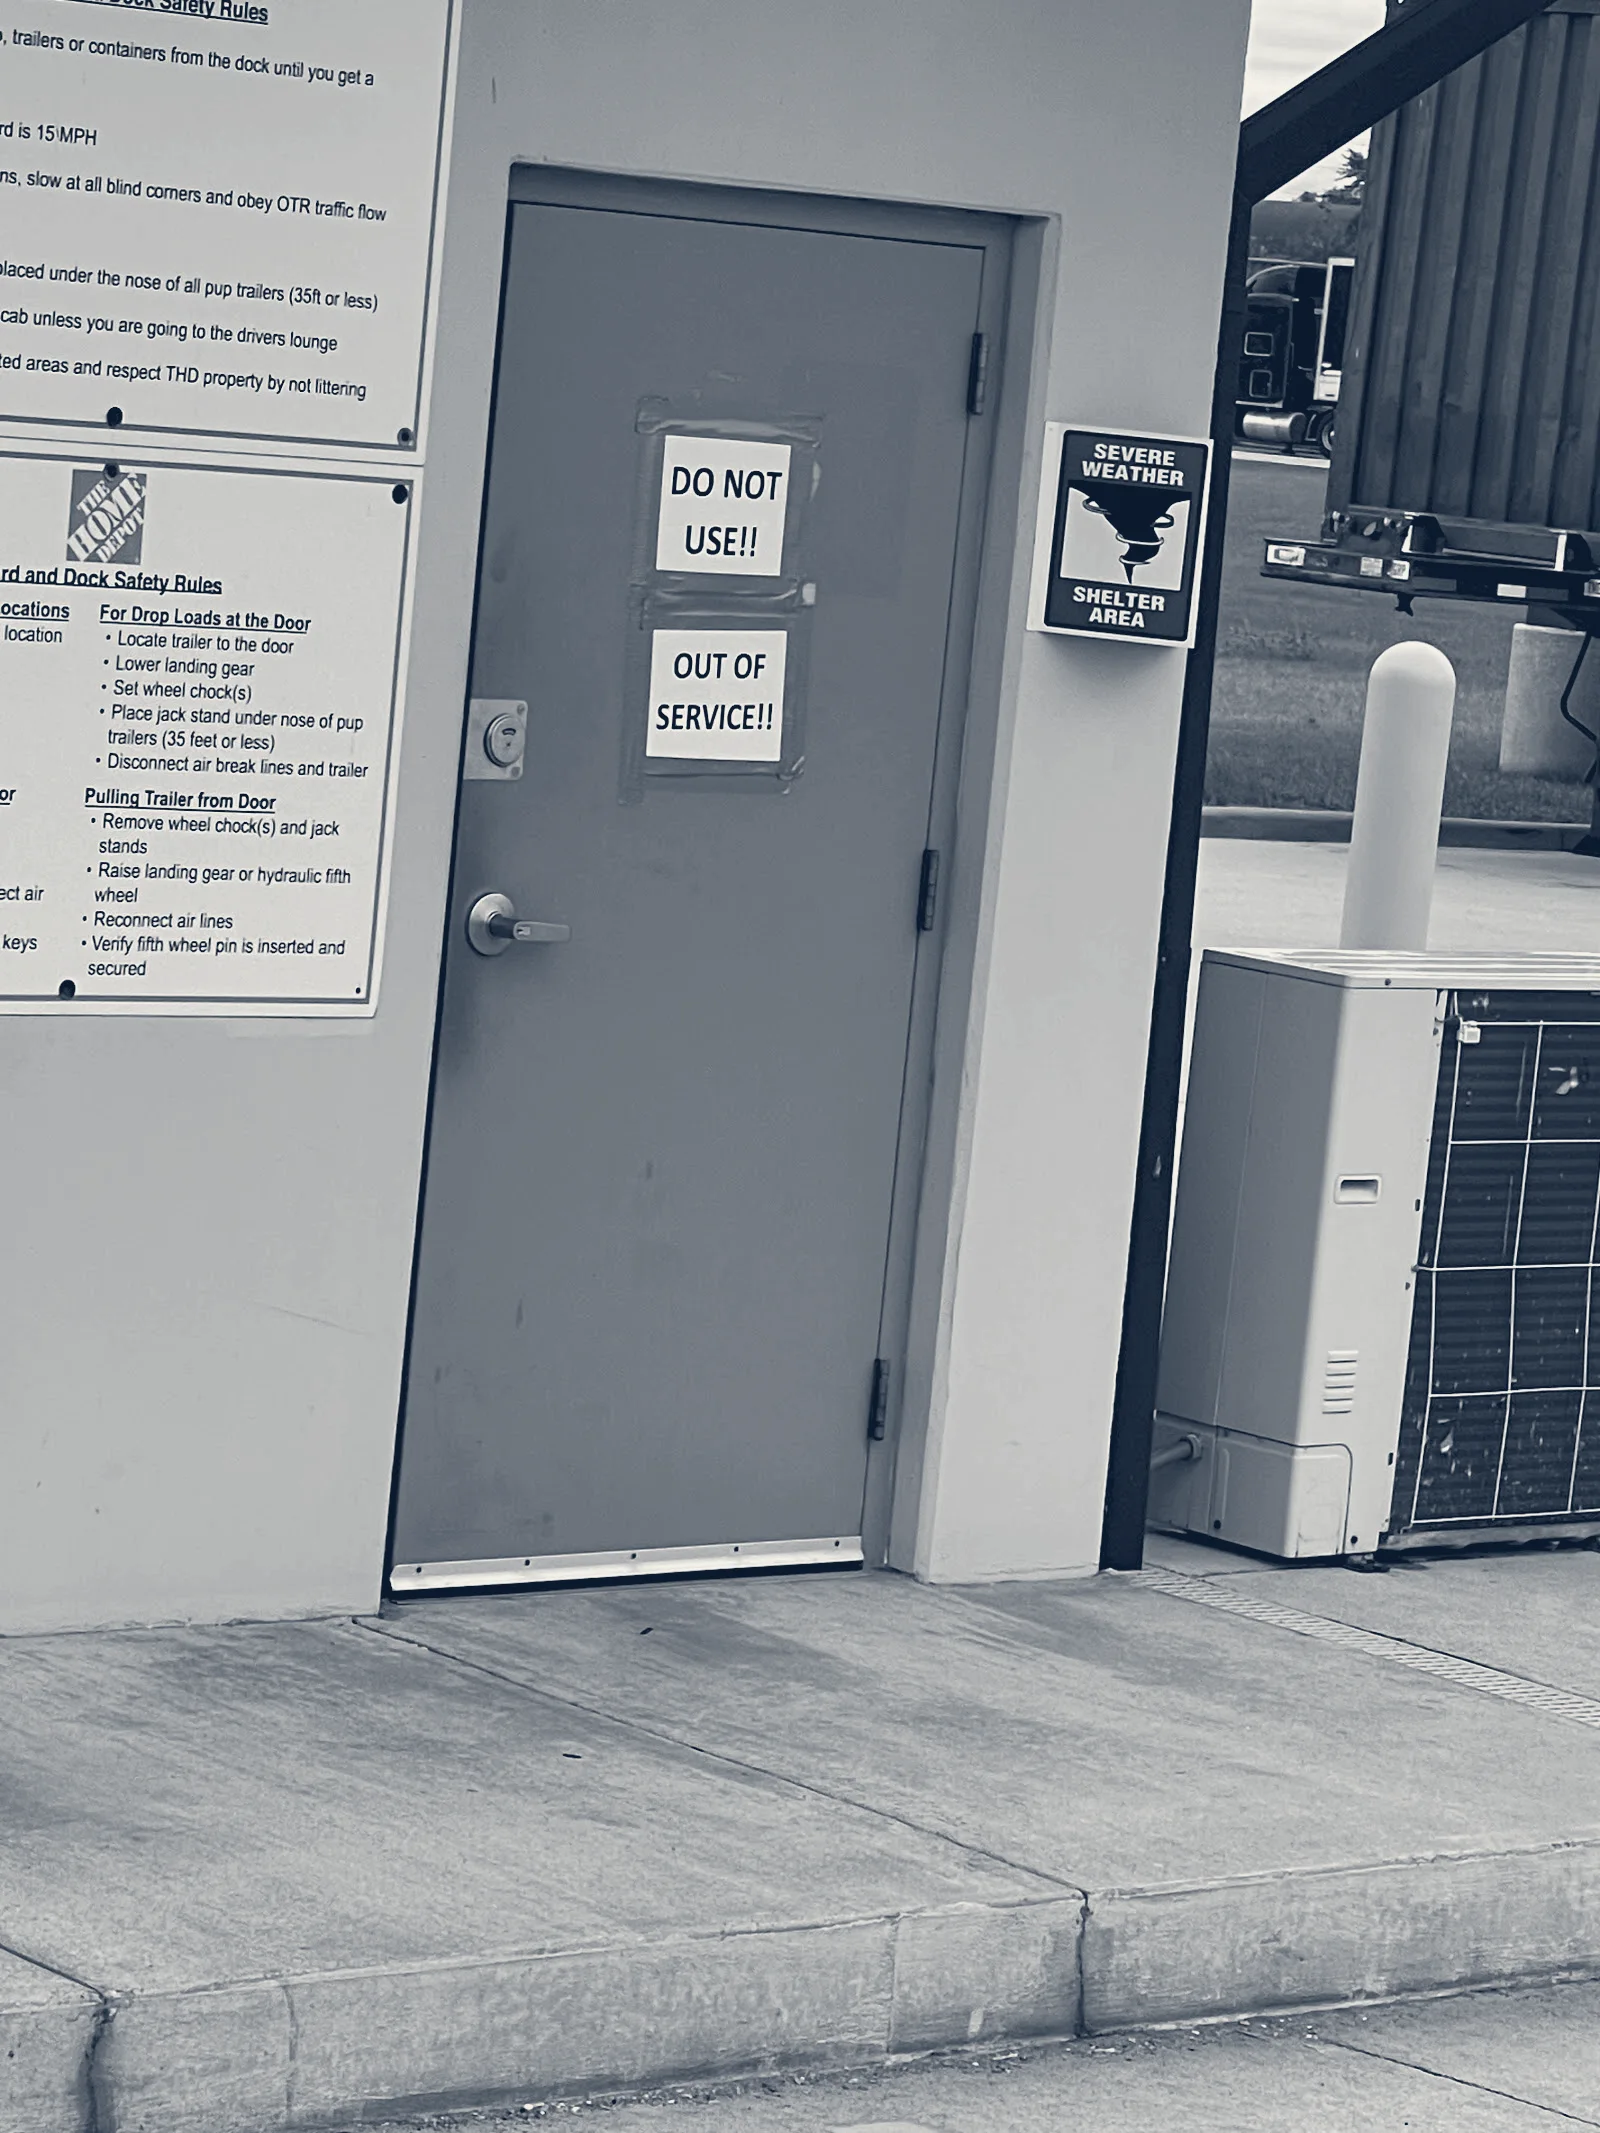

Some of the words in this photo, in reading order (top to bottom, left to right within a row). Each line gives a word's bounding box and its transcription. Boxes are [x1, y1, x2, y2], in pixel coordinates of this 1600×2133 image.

[220, 0, 268, 23] Rules
[13, 29, 64, 49] trailers
[69, 39, 85, 51] or
[89, 41, 166, 61] containers
[171, 46, 203, 65] from
[209, 52, 231, 69] the
[235, 55, 269, 73] dock
[274, 62, 304, 77] until
[308, 67, 334, 83] you
[338, 70, 361, 87] get
[365, 74, 373, 85] a
[18, 122, 31, 139] is
[37, 125, 55, 141] 15
[59, 126, 97, 146] MPH
[27, 170, 62, 188] slow
[66, 175, 80, 190] at
[85, 176, 102, 192] all
[107, 177, 142, 196] blind
[146, 186, 201, 203] corners
[206, 190, 233, 206] and
[237, 192, 273, 214] obey
[277, 196, 310, 214] OTR
[316, 200, 354, 218] traffic
[358, 204, 387, 221] flow
[0, 260, 45, 279] laced
[49, 266, 93, 283] under
[98, 269, 120, 286] the
[125, 276, 161, 290] nose
[166, 276, 181, 291] of
[184, 278, 201, 293] all
[205, 283, 232, 300] pup
[237, 283, 284, 301] trailers
[289, 286, 321, 306] (35ft
[325, 294, 340, 306] or
[344, 292, 377, 313] less)
[0, 308, 28, 324] cab
[33, 311, 82, 329] unless
[86, 318, 114, 334] you
[119, 321, 143, 334] are
[147, 321, 187, 341] going
[193, 324, 206, 339] to
[211, 325, 233, 341] the
[237, 327, 285, 346] drivers
[290, 331, 337, 354] lounge
[26, 359, 68, 373] areas
[73, 360, 102, 376] and
[106, 365, 161, 382] respect
[166, 366, 199, 383] THD
[203, 373, 263, 392] property
[268, 374, 285, 394] by
[289, 379, 311, 393] not
[315, 378, 366, 401] littering
[1094, 443, 1176, 467] SEVERE
[671, 467, 714, 498] DO
[723, 470, 782, 501] NOT
[1082, 461, 1184, 486] WEATHER
[76, 480, 110, 516] THE
[66, 472, 146, 562] HOME
[96, 507, 144, 563] DEPOT
[685, 525, 757, 557] USE!!
[24, 567, 60, 585] and
[63, 568, 112, 589] Dock
[113, 571, 171, 595] Safety
[173, 575, 222, 594] Rules
[1073, 586, 1165, 611] SHELTER
[100, 604, 127, 622] For
[130, 606, 172, 627] Drop
[173, 608, 221, 627] Loads
[225, 612, 240, 628] at
[244, 612, 272, 630] the
[274, 614, 311, 632] Door
[1089, 607, 1145, 628] AREA
[4, 625, 62, 643] location
[118, 630, 167, 648] Locate
[172, 633, 213, 649] trailer
[217, 636, 230, 651] to
[235, 636, 257, 652] the
[261, 638, 294, 654] door
[116, 655, 161, 672] Lower
[165, 657, 217, 679] landing
[222, 663, 255, 679] gear
[673, 652, 728, 679] OUT
[734, 654, 766, 679] OF
[113, 679, 138, 696] Set
[143, 681, 186, 697] wheel
[190, 683, 251, 704] chock(s)
[112, 704, 153, 721] Place
[155, 705, 186, 725] jack
[191, 708, 231, 724] stand
[235, 710, 277, 726] under
[281, 715, 315, 728] nose
[319, 713, 334, 729] of
[337, 718, 363, 733] pup
[656, 704, 773, 730] SERVICE!!
[108, 729, 157, 745] trailers
[162, 730, 185, 750] (35
[190, 731, 217, 748] feet
[221, 737, 237, 749] or
[241, 733, 275, 754] less)
[108, 753, 189, 771] Disconnect
[193, 757, 212, 772] air
[216, 757, 256, 773] break
[260, 759, 293, 775] lines
[298, 761, 324, 776] and
[329, 762, 368, 777] trailer
[84, 788, 142, 809] Pulling
[145, 790, 194, 807] Trailer
[198, 792, 233, 808] from
[239, 793, 276, 809] Door
[103, 813, 163, 830] Remove
[168, 816, 211, 832] wheel
[215, 817, 275, 838] chock(s)
[280, 819, 307, 835] and
[310, 820, 340, 839] jack
[99, 838, 147, 854] stands
[99, 862, 141, 878] Raise
[145, 863, 197, 883] landing
[202, 868, 235, 884] gear
[239, 870, 254, 881] or
[258, 866, 322, 886] hydraulic
[326, 868, 350, 883] fifth
[24, 885, 44, 901] air
[95, 887, 138, 902] wheel
[94, 911, 173, 928] Reconnect
[177, 913, 196, 928] air
[200, 913, 233, 929] lines
[2, 934, 37, 954] keys
[92, 935, 133, 956] Verify
[137, 936, 163, 951] fifth
[169, 937, 211, 952] wheel
[215, 937, 237, 956] pin
[242, 938, 253, 953] is
[257, 938, 314, 954] inserted
[318, 940, 345, 955] and
[88, 960, 146, 976] secured
